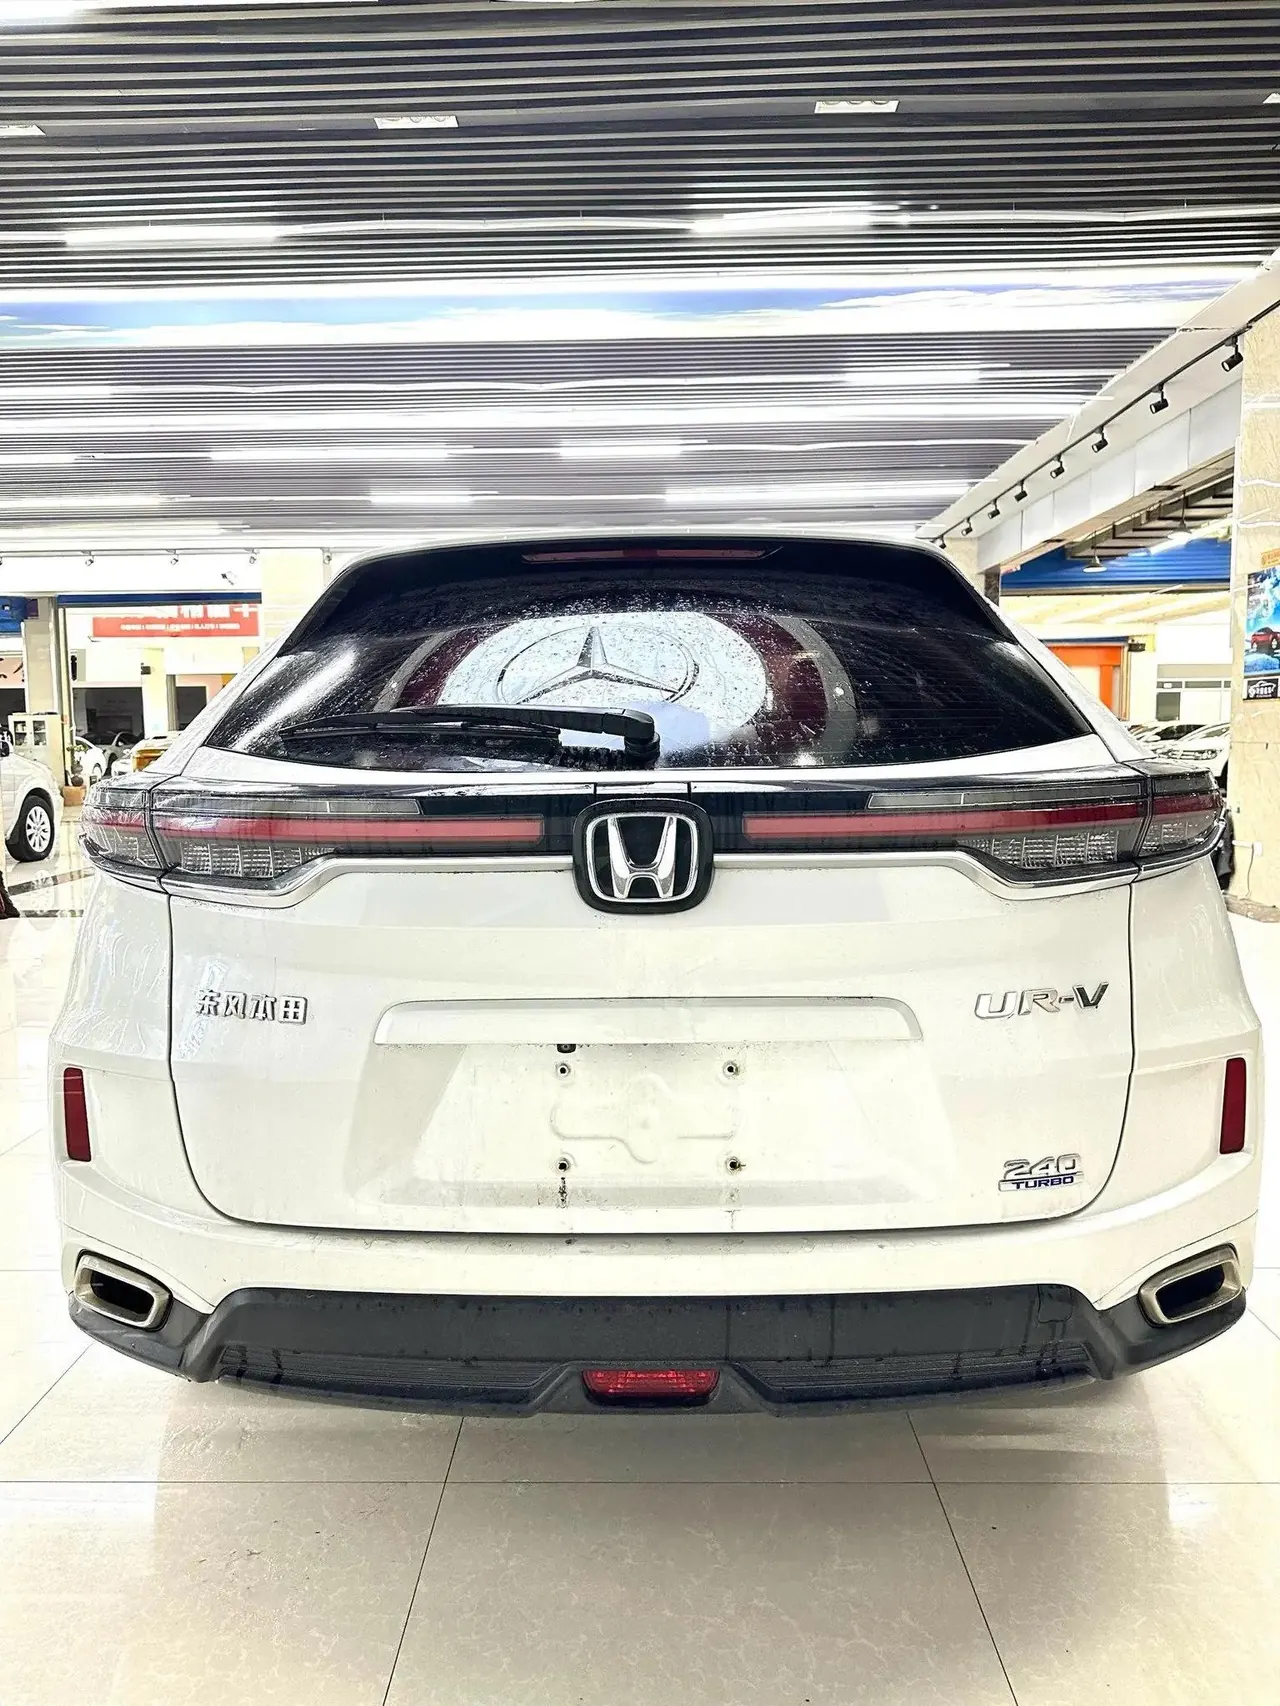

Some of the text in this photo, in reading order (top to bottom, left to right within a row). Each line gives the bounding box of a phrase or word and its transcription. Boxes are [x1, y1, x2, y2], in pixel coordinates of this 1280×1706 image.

[196, 989, 308, 1025] 东风本田
[974, 981, 1109, 1019] UR-V
[1003, 1153, 1081, 1178] 240
[1011, 1175, 1075, 1190] TURBO
